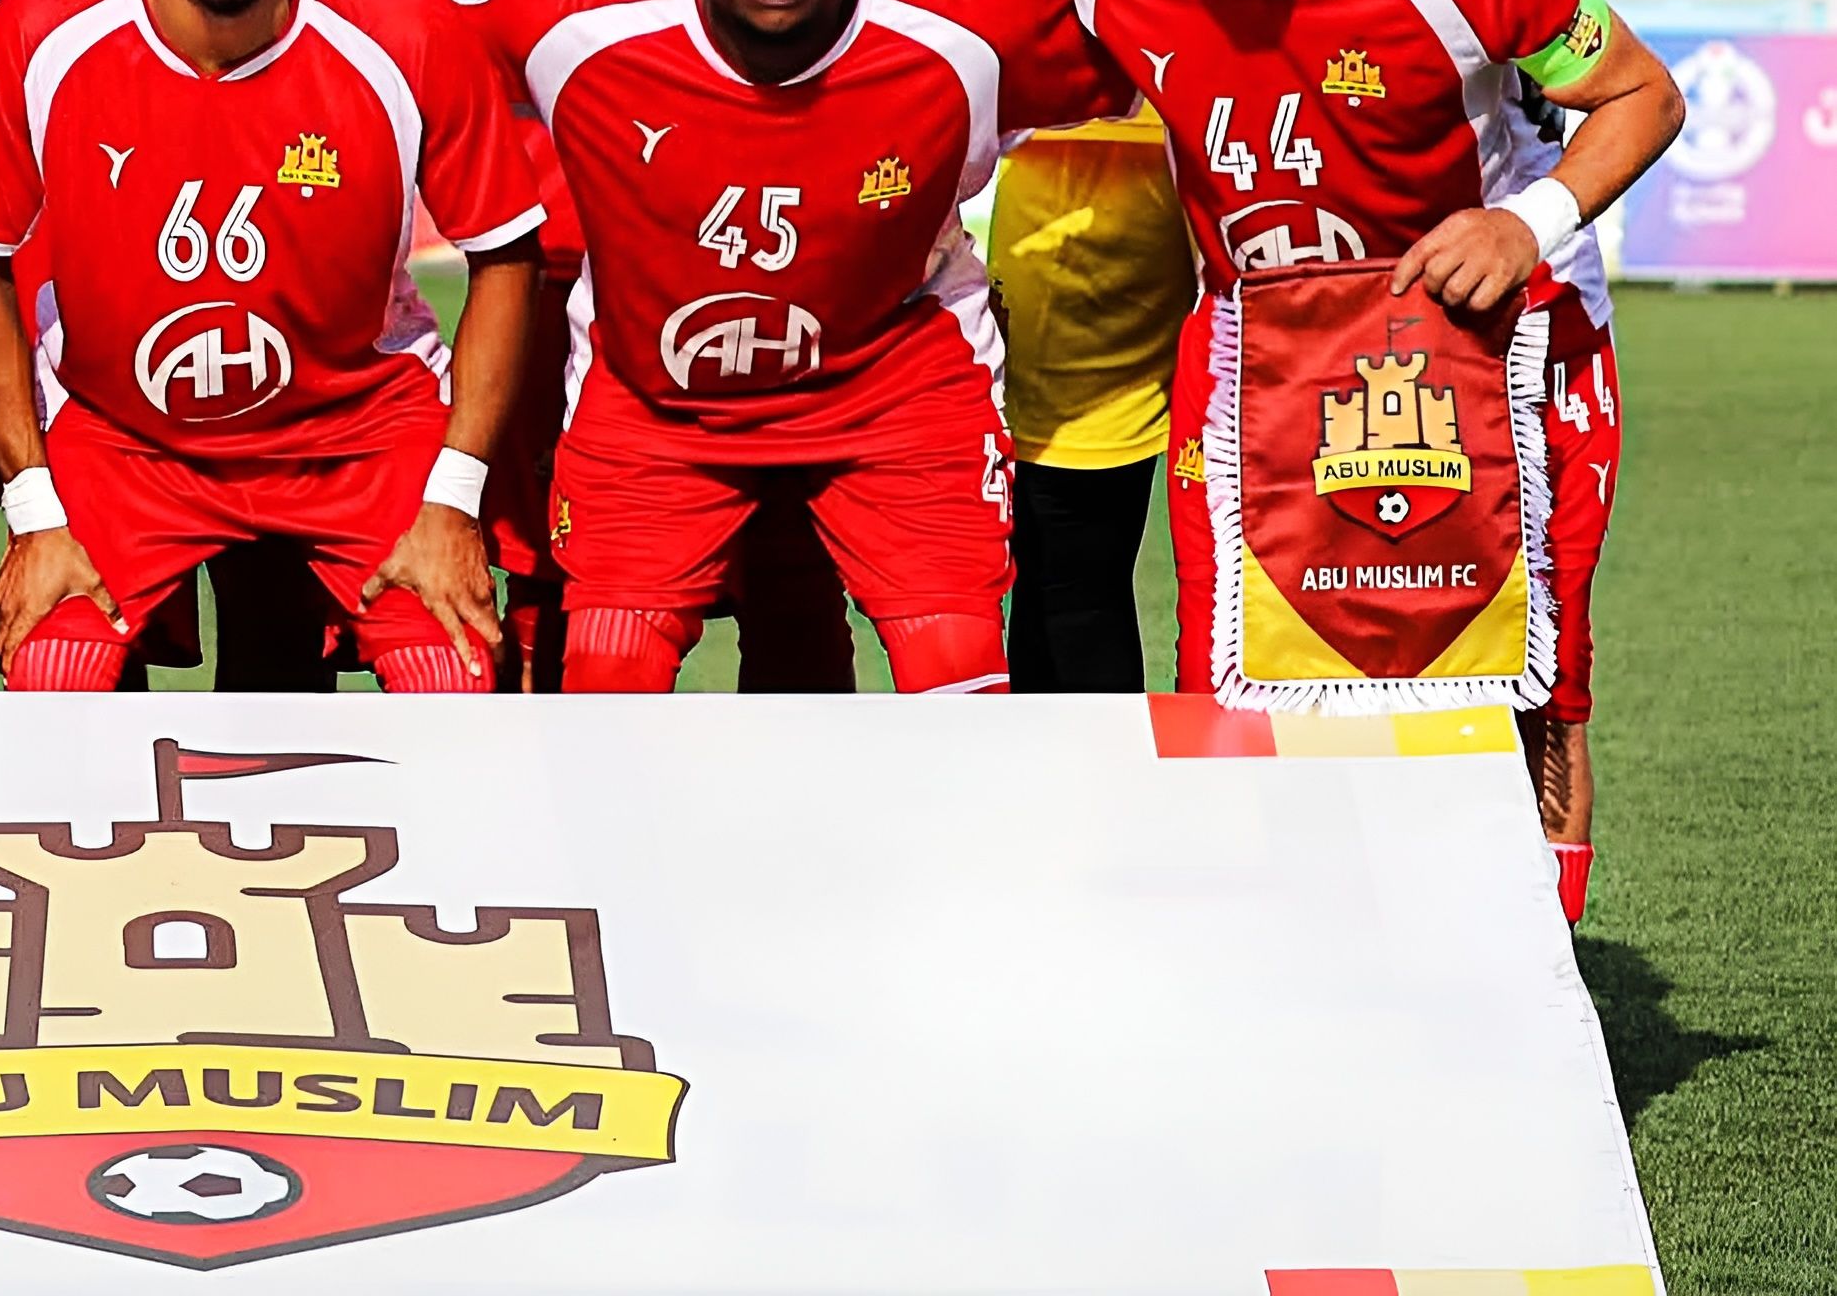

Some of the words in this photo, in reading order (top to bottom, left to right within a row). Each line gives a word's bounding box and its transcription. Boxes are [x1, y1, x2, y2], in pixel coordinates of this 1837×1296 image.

[1204, 92, 1323, 192] 44
[157, 179, 267, 283] 66
[697, 184, 802, 273] 45
[1553, 353, 1616, 434] 44
[1323, 459, 1370, 481] ABU
[1377, 459, 1463, 481] MUSLIM
[1301, 567, 1349, 592] ABU
[1356, 565, 1444, 590] MUSLIM
[1451, 563, 1477, 588] FC
[75, 1068, 605, 1132] MUSLIM
